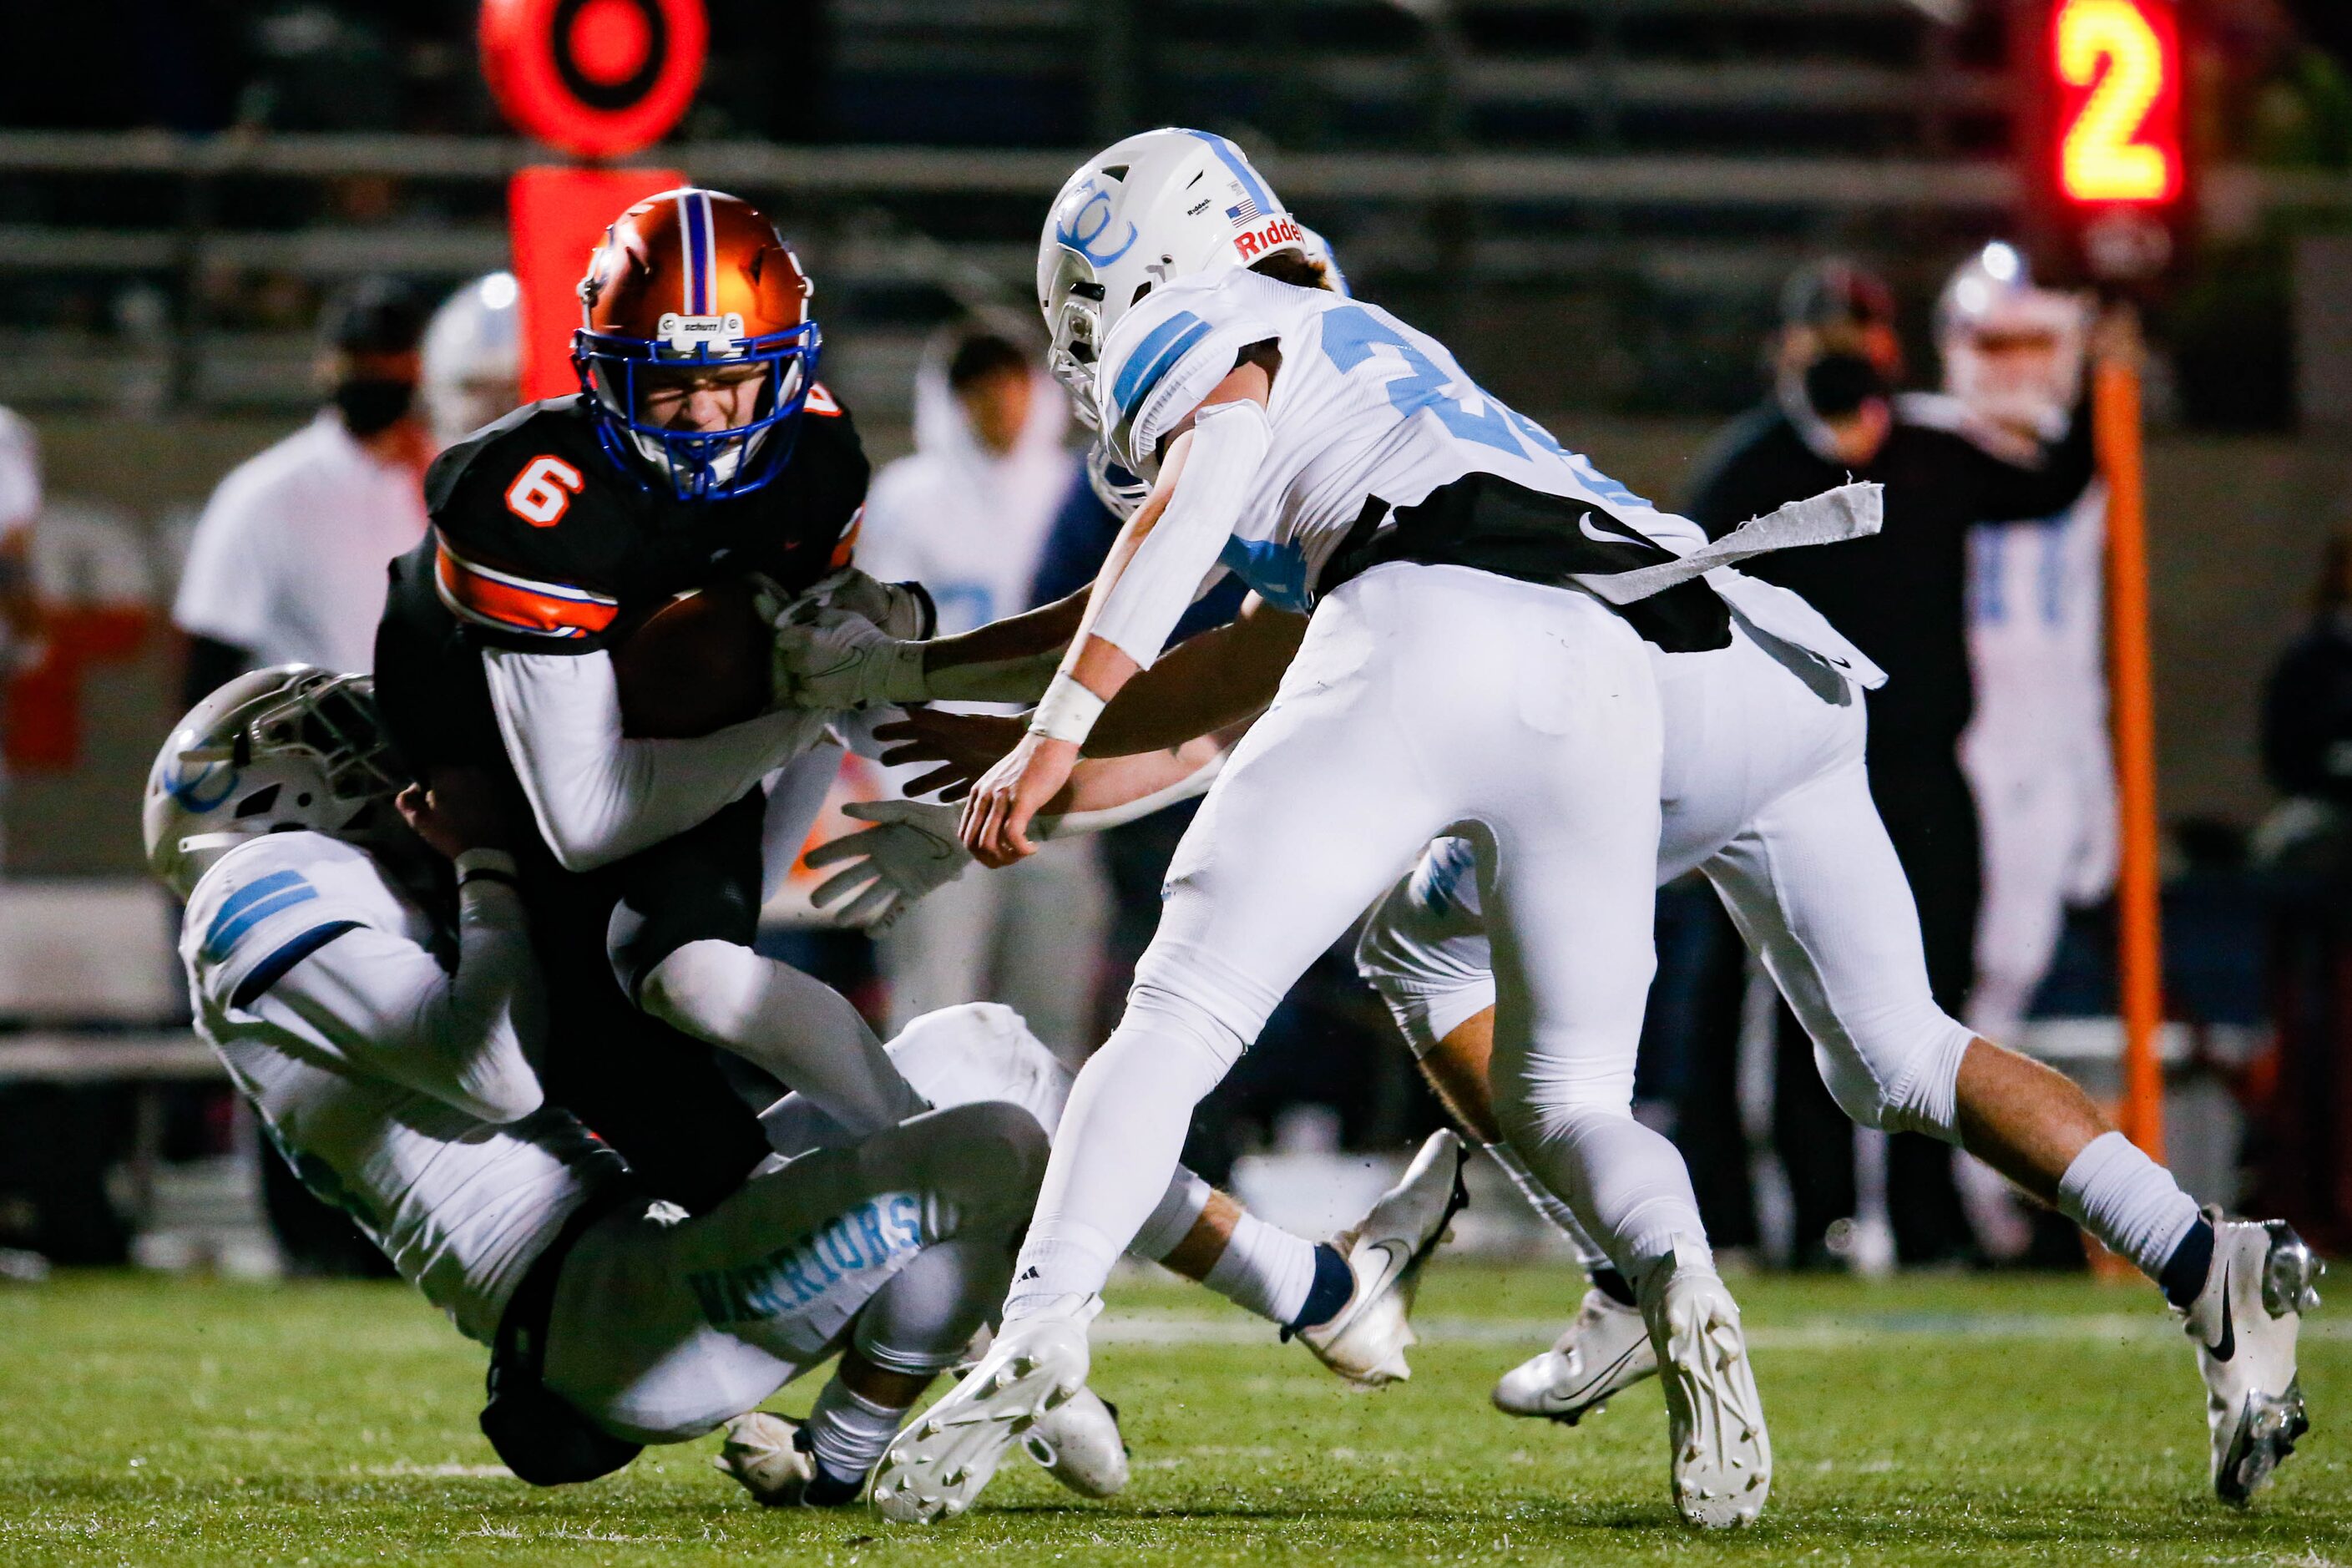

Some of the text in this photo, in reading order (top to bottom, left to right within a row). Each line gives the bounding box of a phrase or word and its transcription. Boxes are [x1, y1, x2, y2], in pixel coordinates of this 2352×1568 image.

[2057, 0, 2166, 200] 2
[1233, 218, 1305, 262] Ridde
[504, 453, 584, 528] 6
